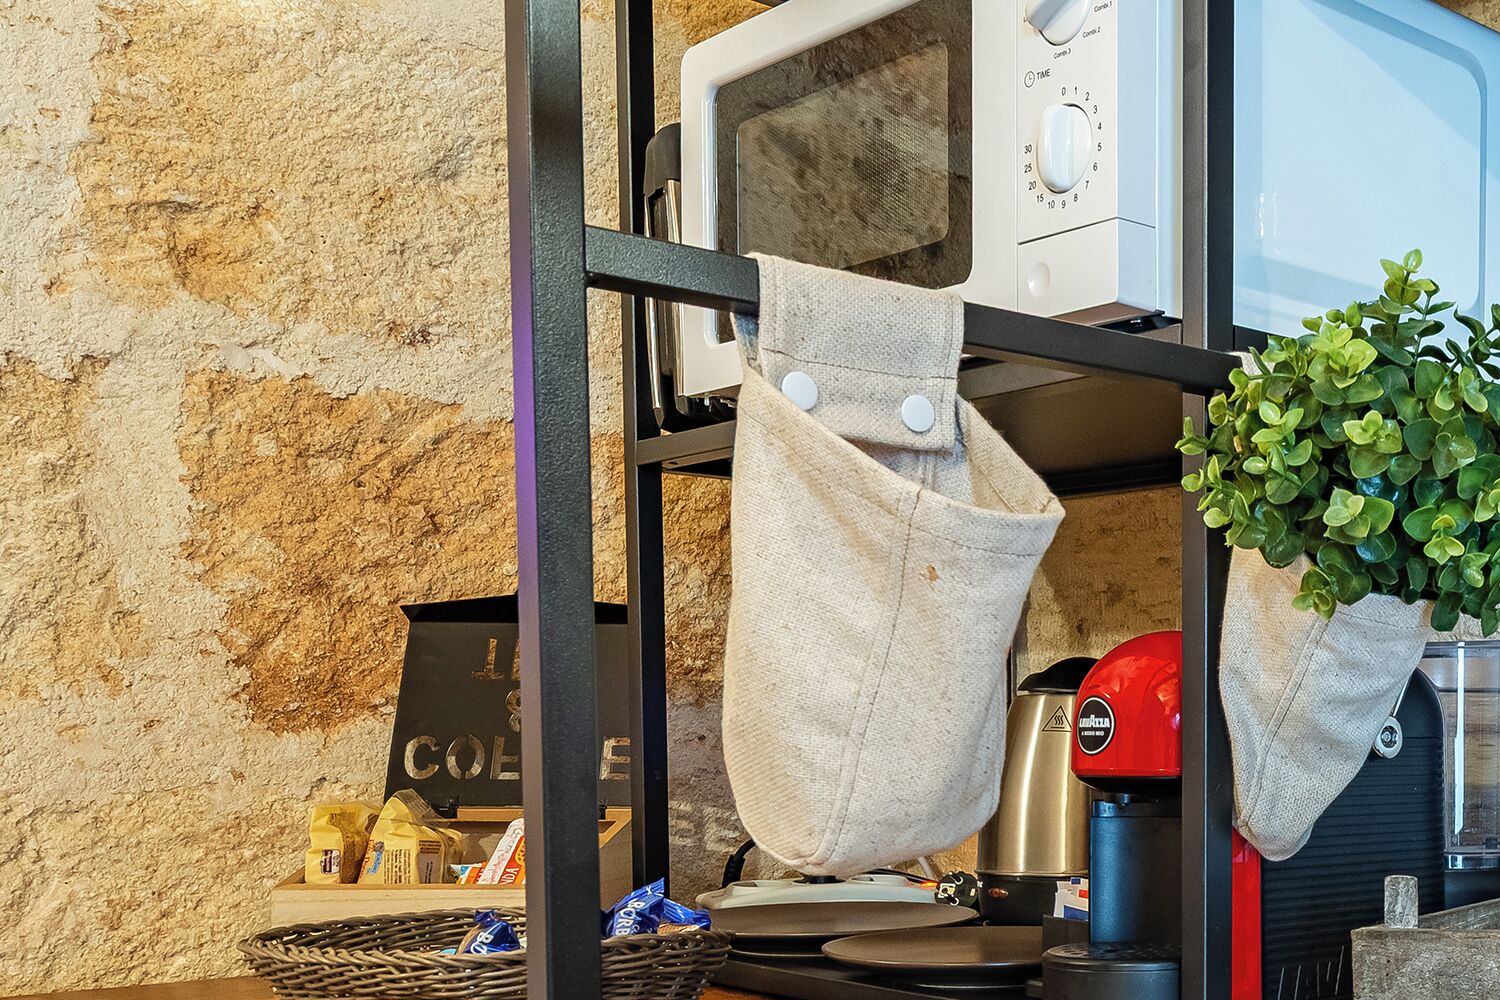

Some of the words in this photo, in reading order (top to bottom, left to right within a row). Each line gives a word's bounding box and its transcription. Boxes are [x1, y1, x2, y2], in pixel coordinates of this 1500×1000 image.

[1036, 68, 1051, 80] TIME
[1061, 86, 1066, 96] 0
[1074, 86, 1078, 95] 1
[1085, 91, 1090, 101] 2
[1093, 105, 1098, 114] 3
[1097, 122, 1102, 130] 4
[1024, 144, 1032, 154] 30
[1097, 142, 1102, 152] 5
[1024, 163, 1032, 173] 25
[1093, 162, 1098, 171] 6
[1028, 180, 1037, 190] 20
[1085, 180, 1089, 189] 7
[1036, 193, 1044, 203] 15
[1073, 193, 1078, 202] 8
[1047, 200, 1056, 209] 10
[1061, 200, 1066, 209] 9
[1079, 715, 1110, 728] LAVAZZA
